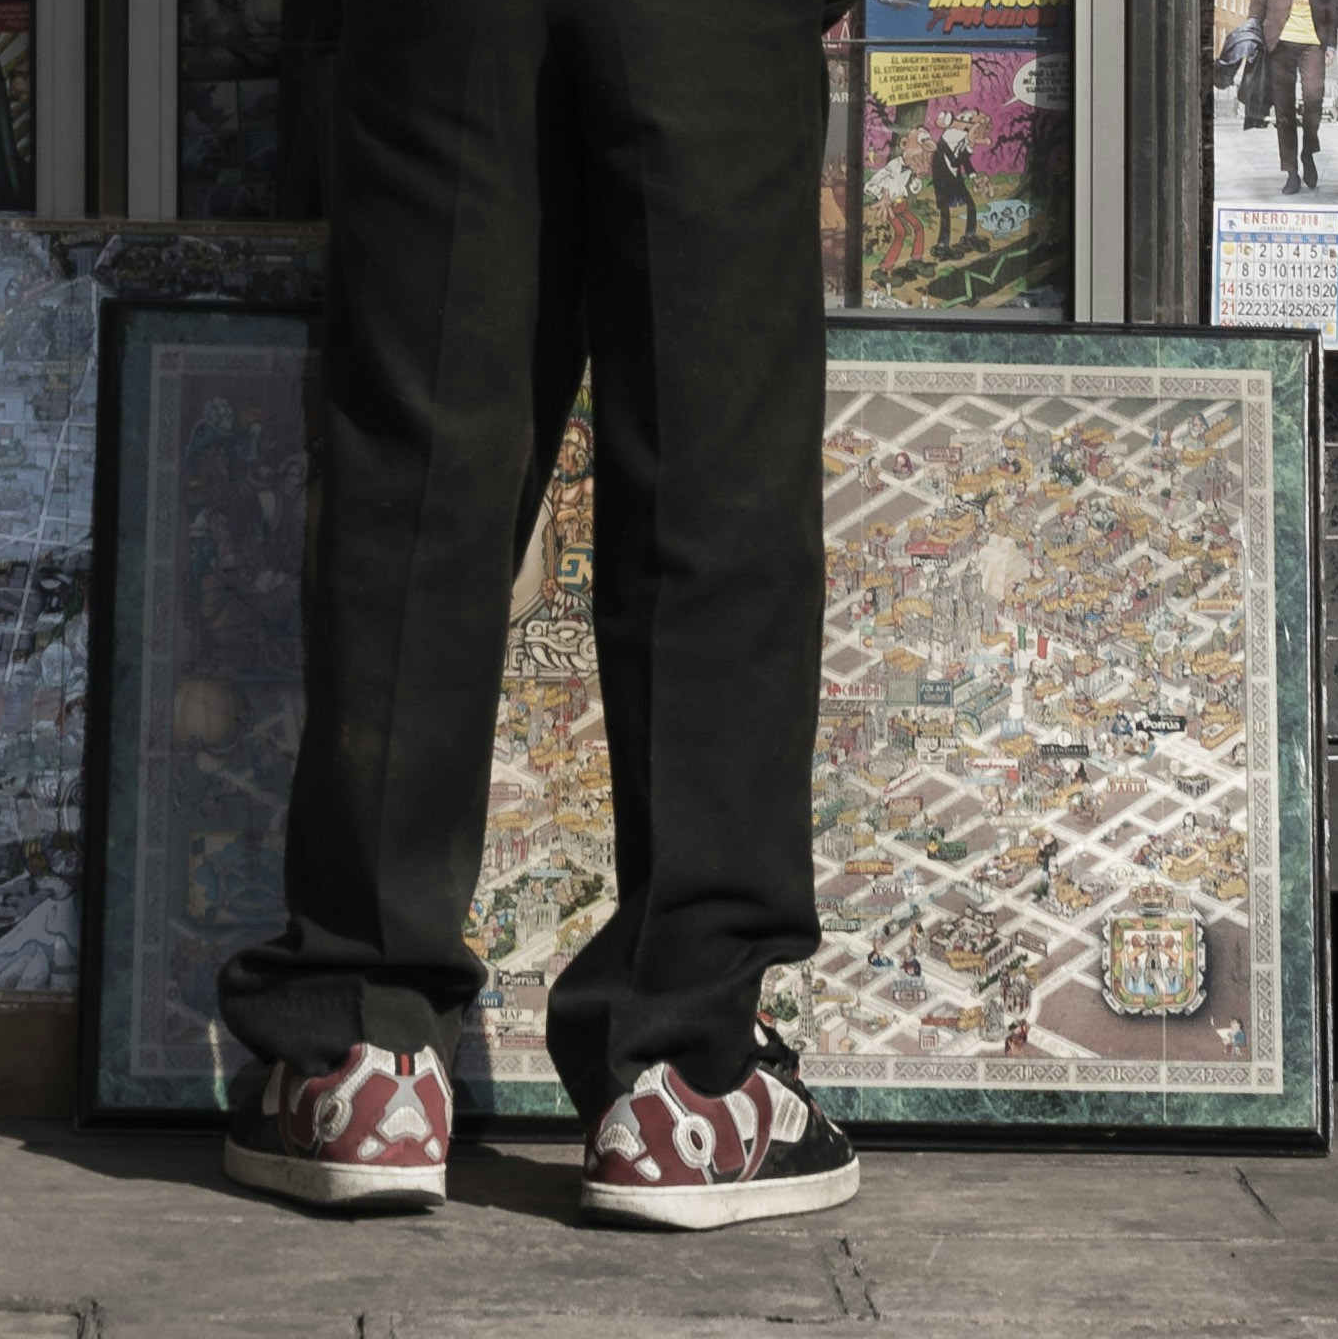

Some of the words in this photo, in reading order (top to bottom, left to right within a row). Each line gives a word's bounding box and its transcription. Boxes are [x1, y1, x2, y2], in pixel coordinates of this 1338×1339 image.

[1244, 212, 1289, 226] ENERO
[1295, 213, 1318, 227] 2018
[842, 684, 881, 697] CANADA
[1143, 720, 1180, 731] Porrúa
